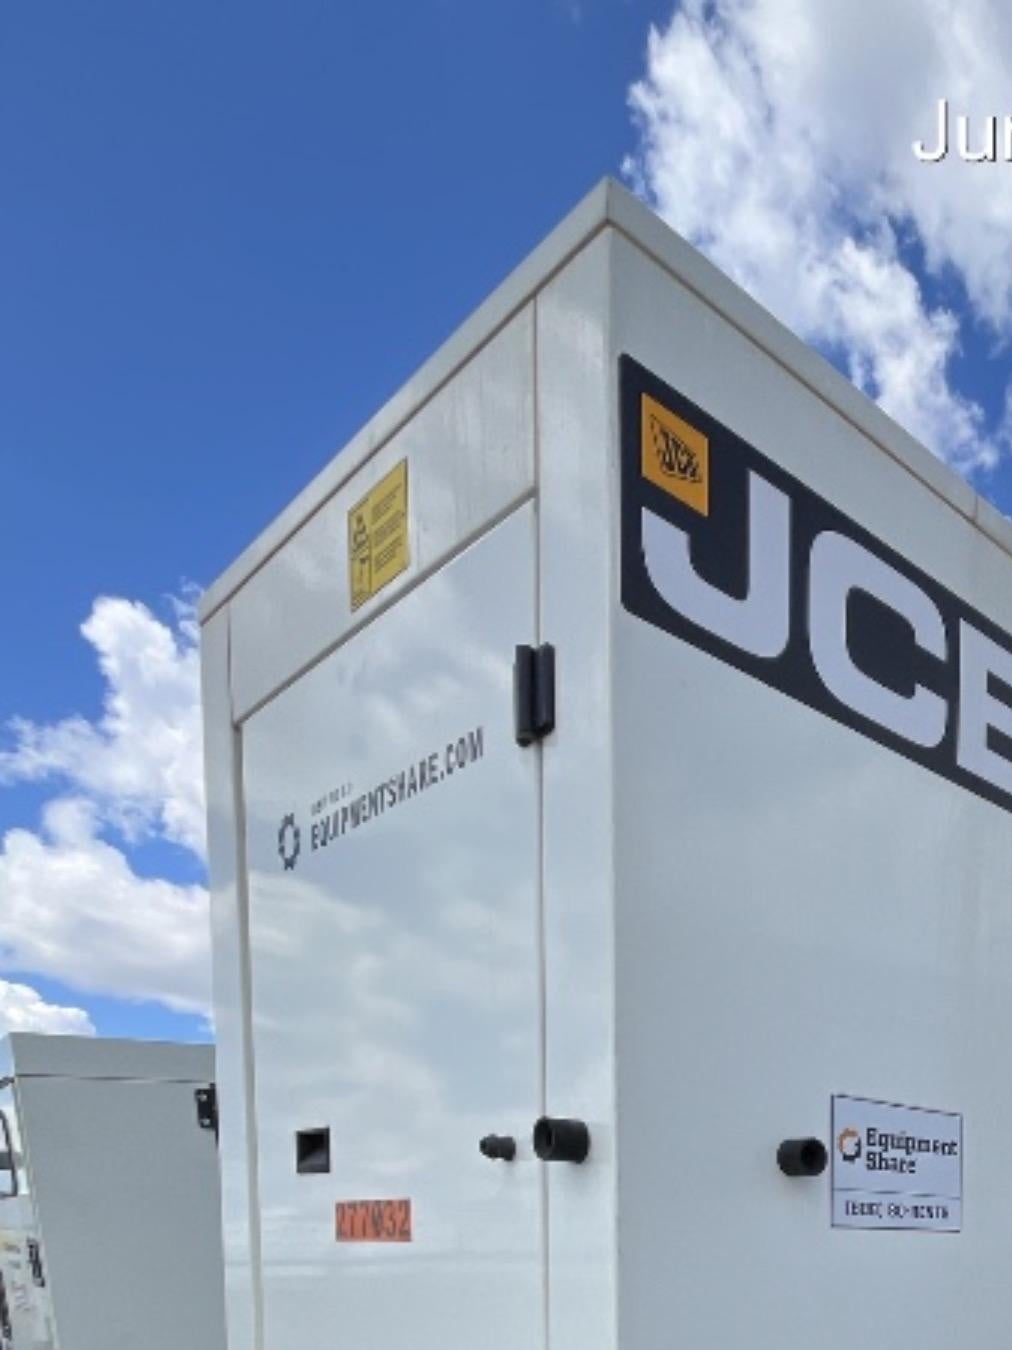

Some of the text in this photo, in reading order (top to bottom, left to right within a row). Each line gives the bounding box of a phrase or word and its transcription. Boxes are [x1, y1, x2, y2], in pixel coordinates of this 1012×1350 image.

[311, 726, 484, 852] EQUIPMENTSHARE.COM
[865, 1126, 958, 1156] Equipment
[865, 1152, 917, 1174] Share
